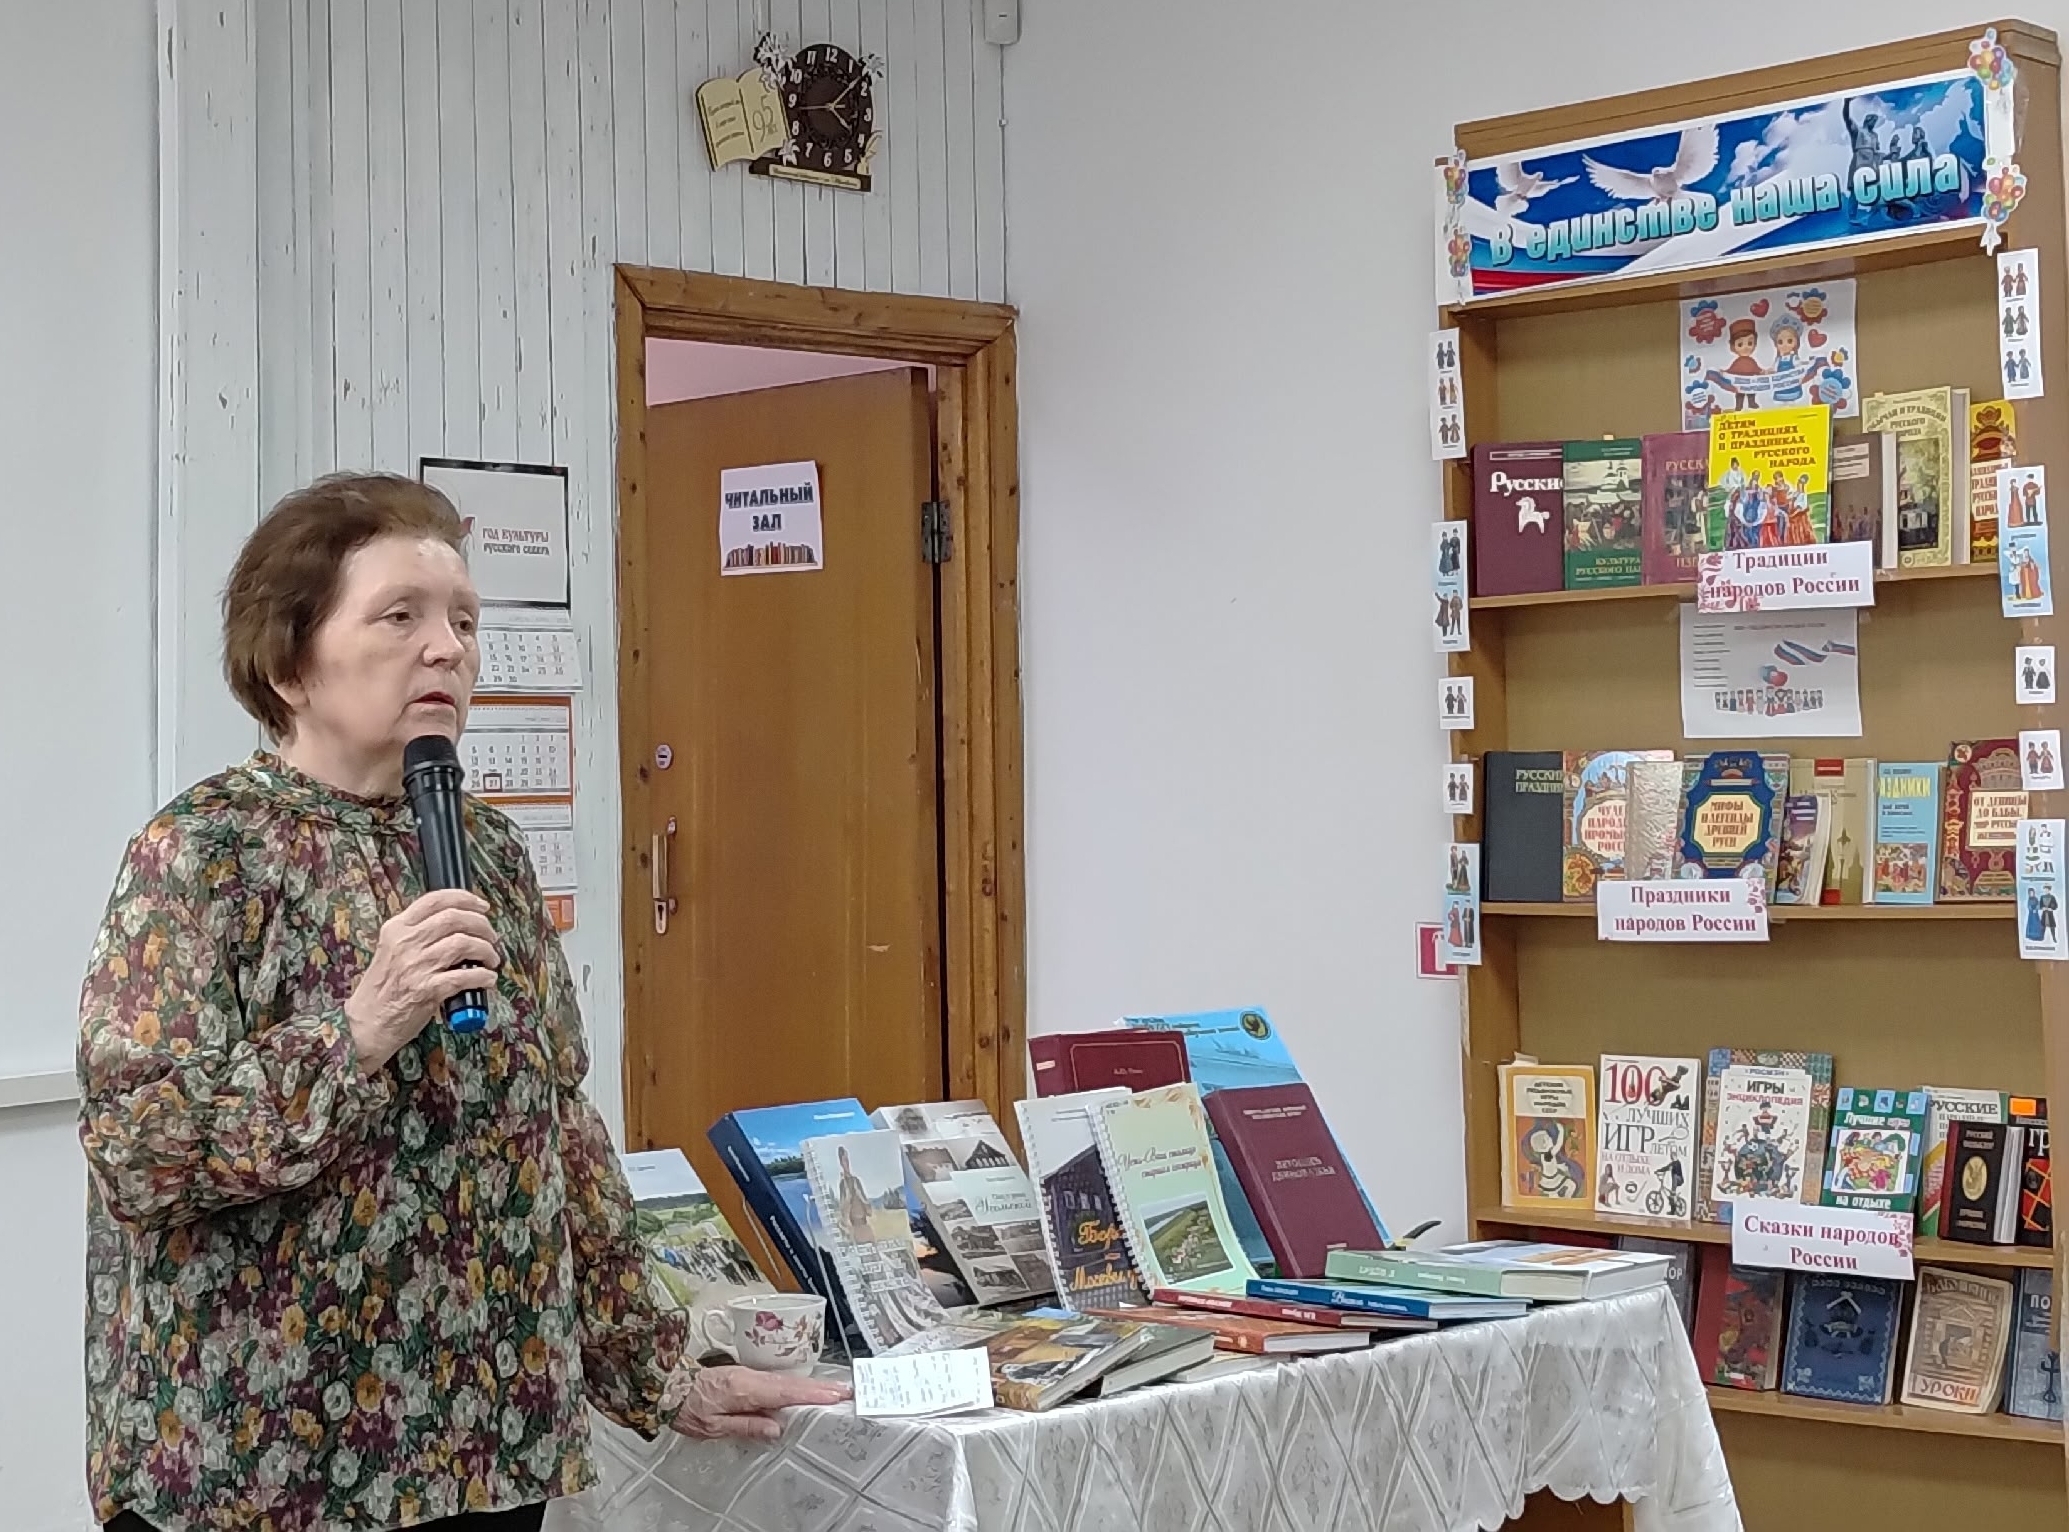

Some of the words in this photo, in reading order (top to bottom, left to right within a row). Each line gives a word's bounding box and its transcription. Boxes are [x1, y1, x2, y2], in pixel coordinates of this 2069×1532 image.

[808, 51, 816, 64] 11
[826, 48, 837, 62] 12
[848, 60, 853, 72] 1
[791, 69, 802, 83] 10
[861, 82, 868, 96] 2
[789, 94, 797, 108] 9
[864, 109, 871, 121] 3
[792, 121, 799, 135] 8
[805, 143, 813, 157] 7
[845, 149, 852, 163] 5
[824, 153, 831, 167] 6
[1526, 194, 1719, 261] единстве
[1730, 173, 1842, 226] наша
[1853, 153, 1961, 205] сила
[1719, 420, 1755, 431] ДЕТЯМ
[1719, 432, 1725, 440] О
[1731, 425, 1798, 440] ТРАДИЦИЯХ
[1731, 436, 1805, 449] ПРАЗДНИКАХ
[1754, 447, 1810, 459] РУССКОГО
[1769, 457, 1816, 468] НАРОДА
[725, 482, 814, 509] ЧИТАЛЬНЫЙ
[752, 514, 782, 532] ЗАЛ
[483, 528, 499, 539] ГОД
[502, 529, 549, 543] КУЛЬТУРЫ
[483, 543, 520, 554] РУССКОГО
[1733, 551, 1828, 573] Традиции
[1711, 582, 1785, 600] народов
[1793, 577, 1859, 594] России
[1710, 801, 1743, 811] МИФЫ
[1709, 813, 1754, 824] ЛЕГЕНДЫ
[1704, 824, 1747, 836] ДРЕВНЕЙ
[1712, 837, 1737, 847] РУСИ
[1631, 886, 1730, 907] Праздники
[1615, 917, 1685, 935] народов
[1692, 914, 1756, 931] России
[1604, 1063, 1667, 1107] 100
[1747, 1081, 1785, 1094] ИГРЫ
[1626, 1108, 1689, 1127] ЛУЧШИХ
[1604, 1124, 1655, 1153] ИГР
[1650, 1143, 1687, 1156] ЛЕТОМ
[1615, 1153, 1650, 1164] ОТДЫХЕ
[1626, 1165, 1650, 1175] ДОМА
[1744, 1215, 1813, 1237] Сказки
[1821, 1227, 1900, 1248] народов
[1790, 1247, 1858, 1270] России
[1664, 1267, 1683, 1280] ОР
[1920, 1378, 1979, 1401] УРОКИ
